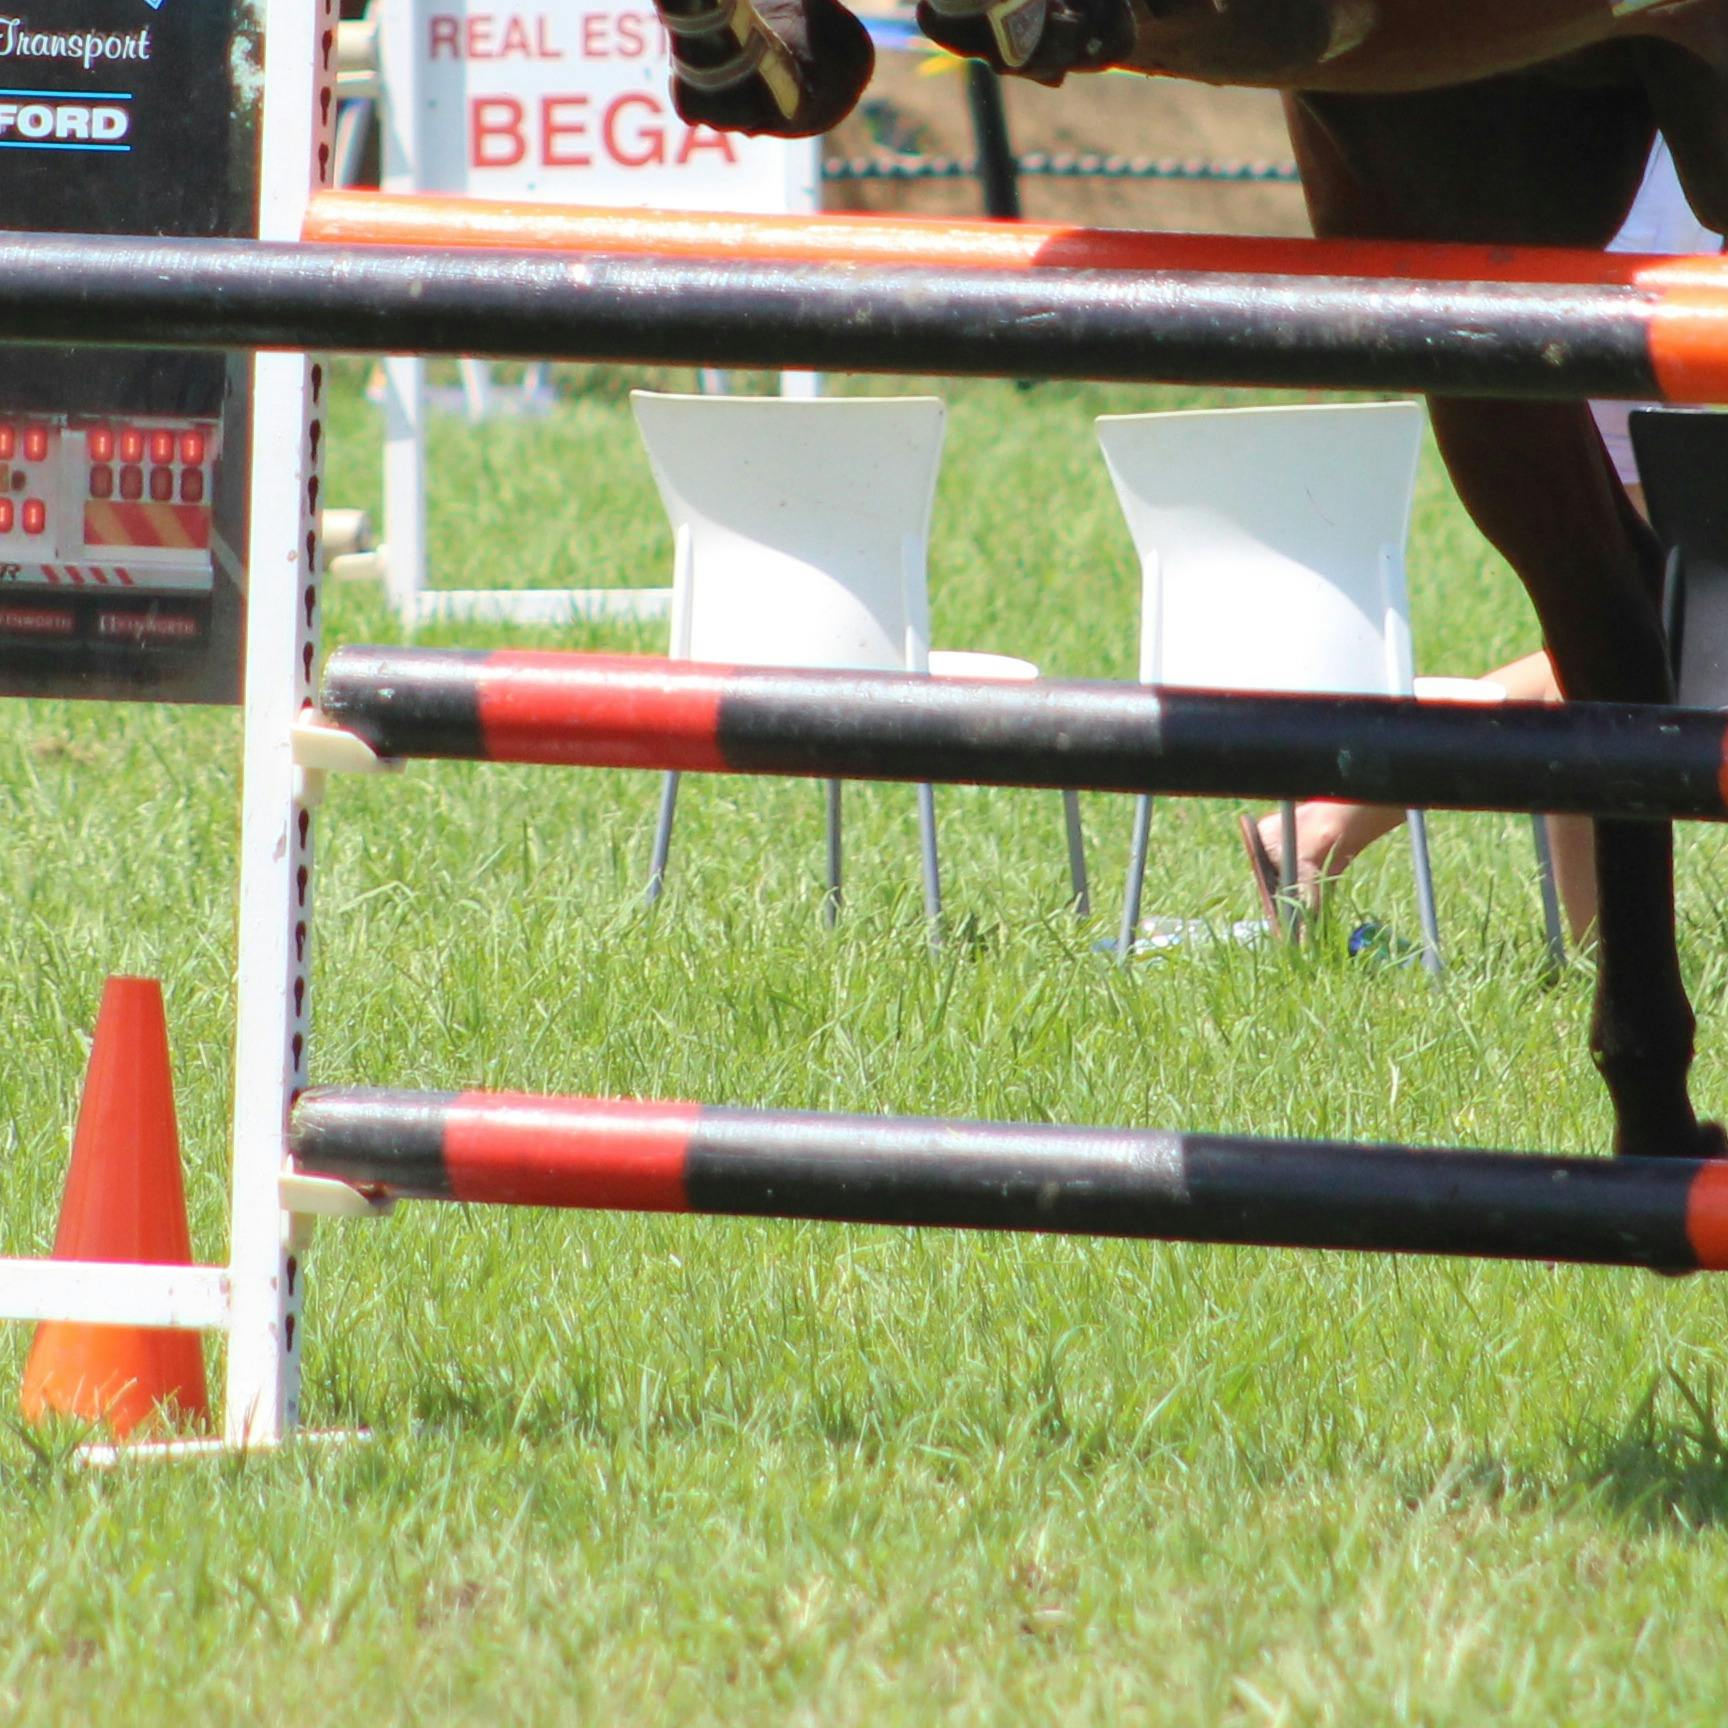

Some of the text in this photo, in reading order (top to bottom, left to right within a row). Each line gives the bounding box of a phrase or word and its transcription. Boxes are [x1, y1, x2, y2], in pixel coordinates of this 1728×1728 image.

[429, 13, 669, 59] REAL EST
[471, 92, 738, 168] BEGA
